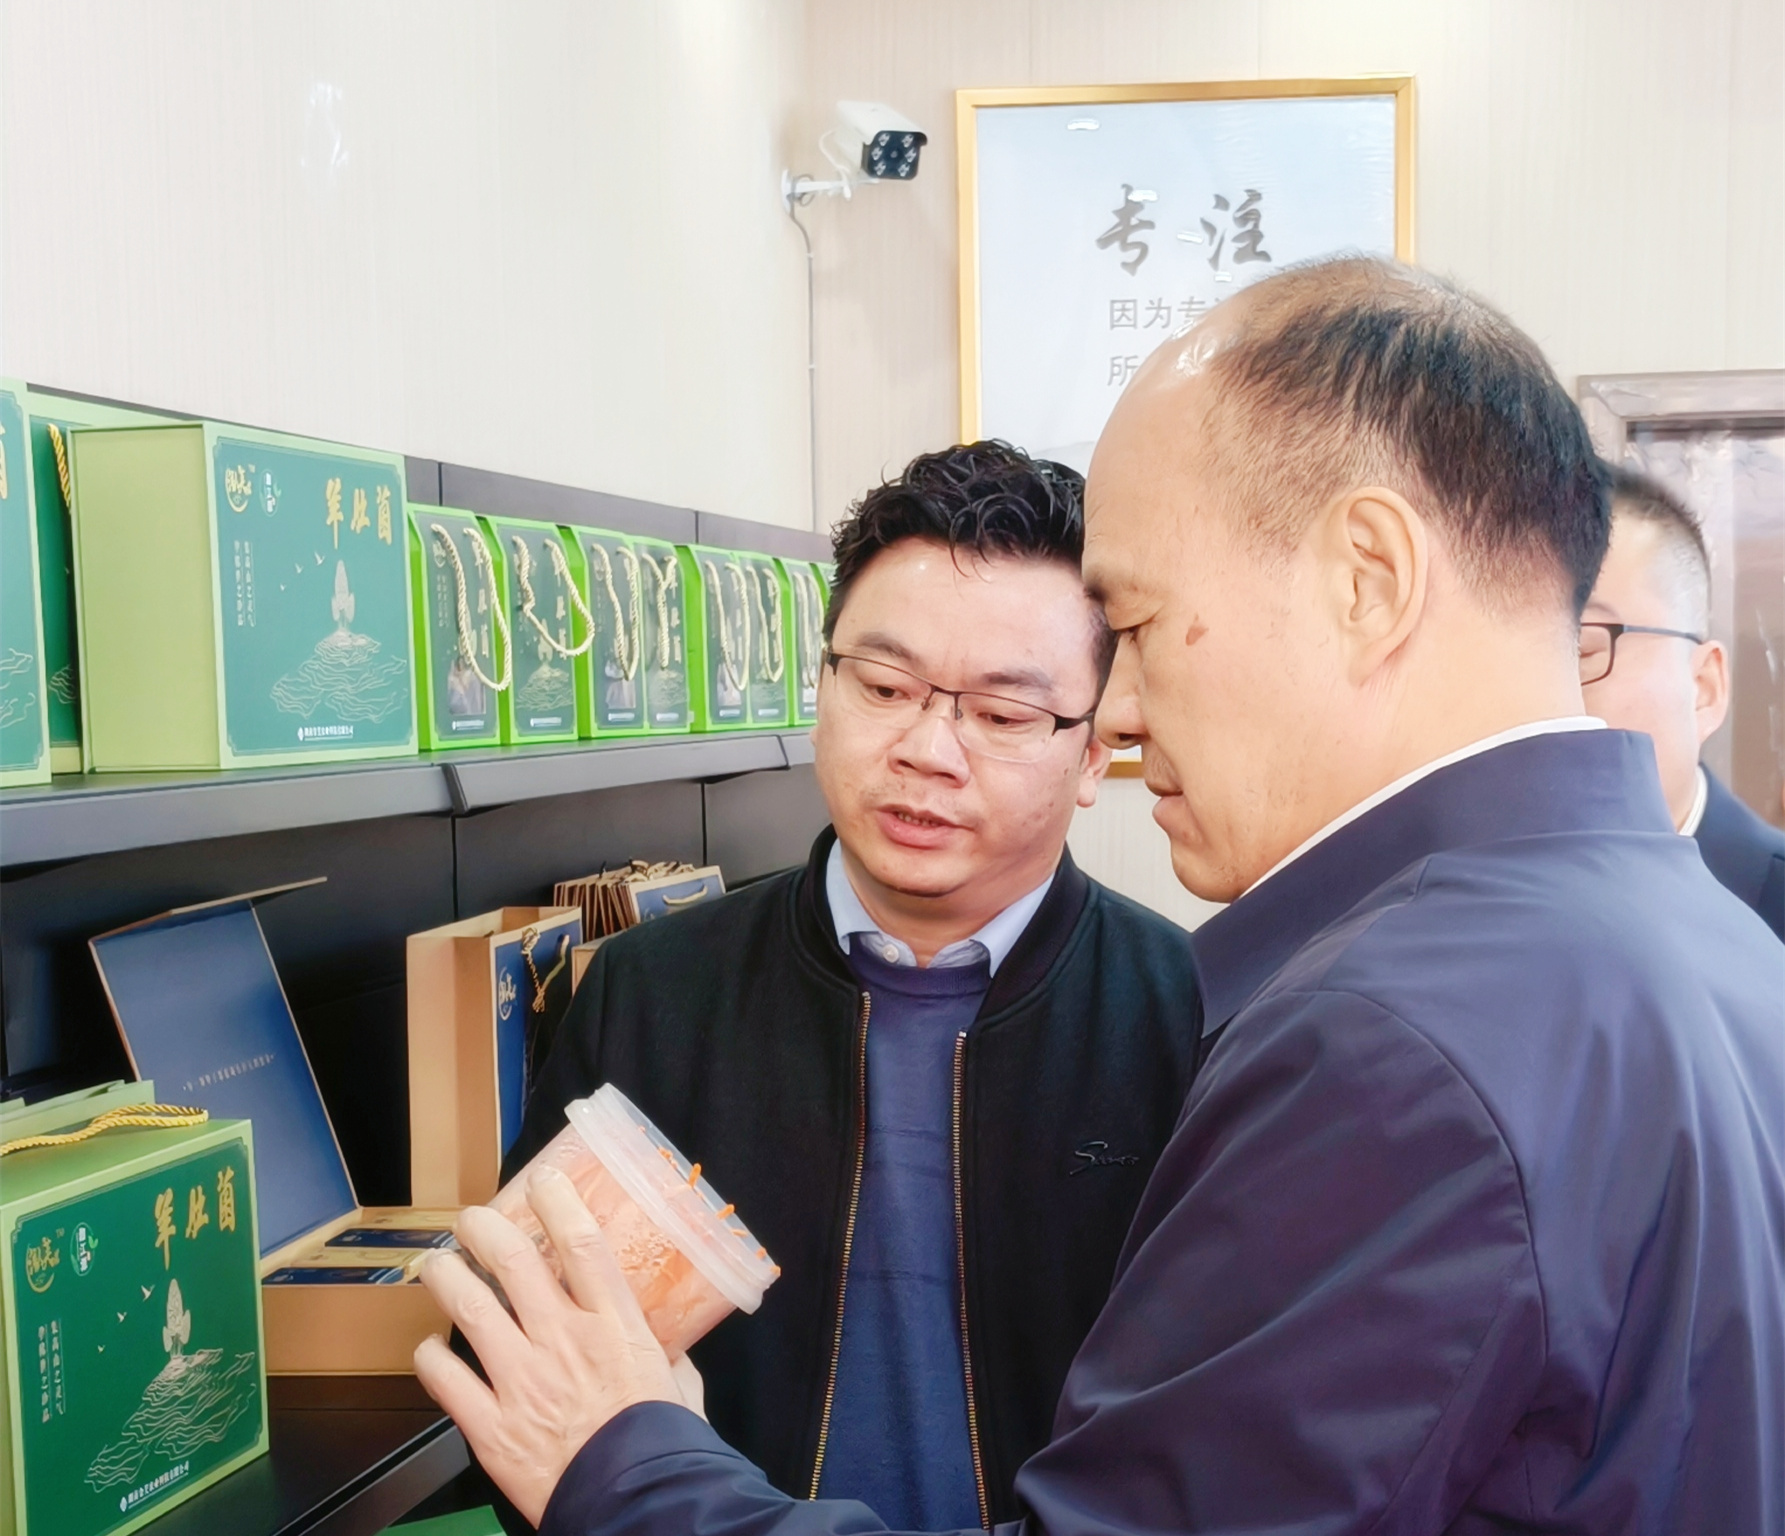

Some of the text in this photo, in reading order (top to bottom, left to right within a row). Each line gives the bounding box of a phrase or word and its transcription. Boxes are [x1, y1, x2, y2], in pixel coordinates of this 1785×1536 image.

[1096, 183, 1272, 277] 专注
[1109, 296, 1221, 330] 因为专
[155, 1166, 236, 1271] 羊肚菌
